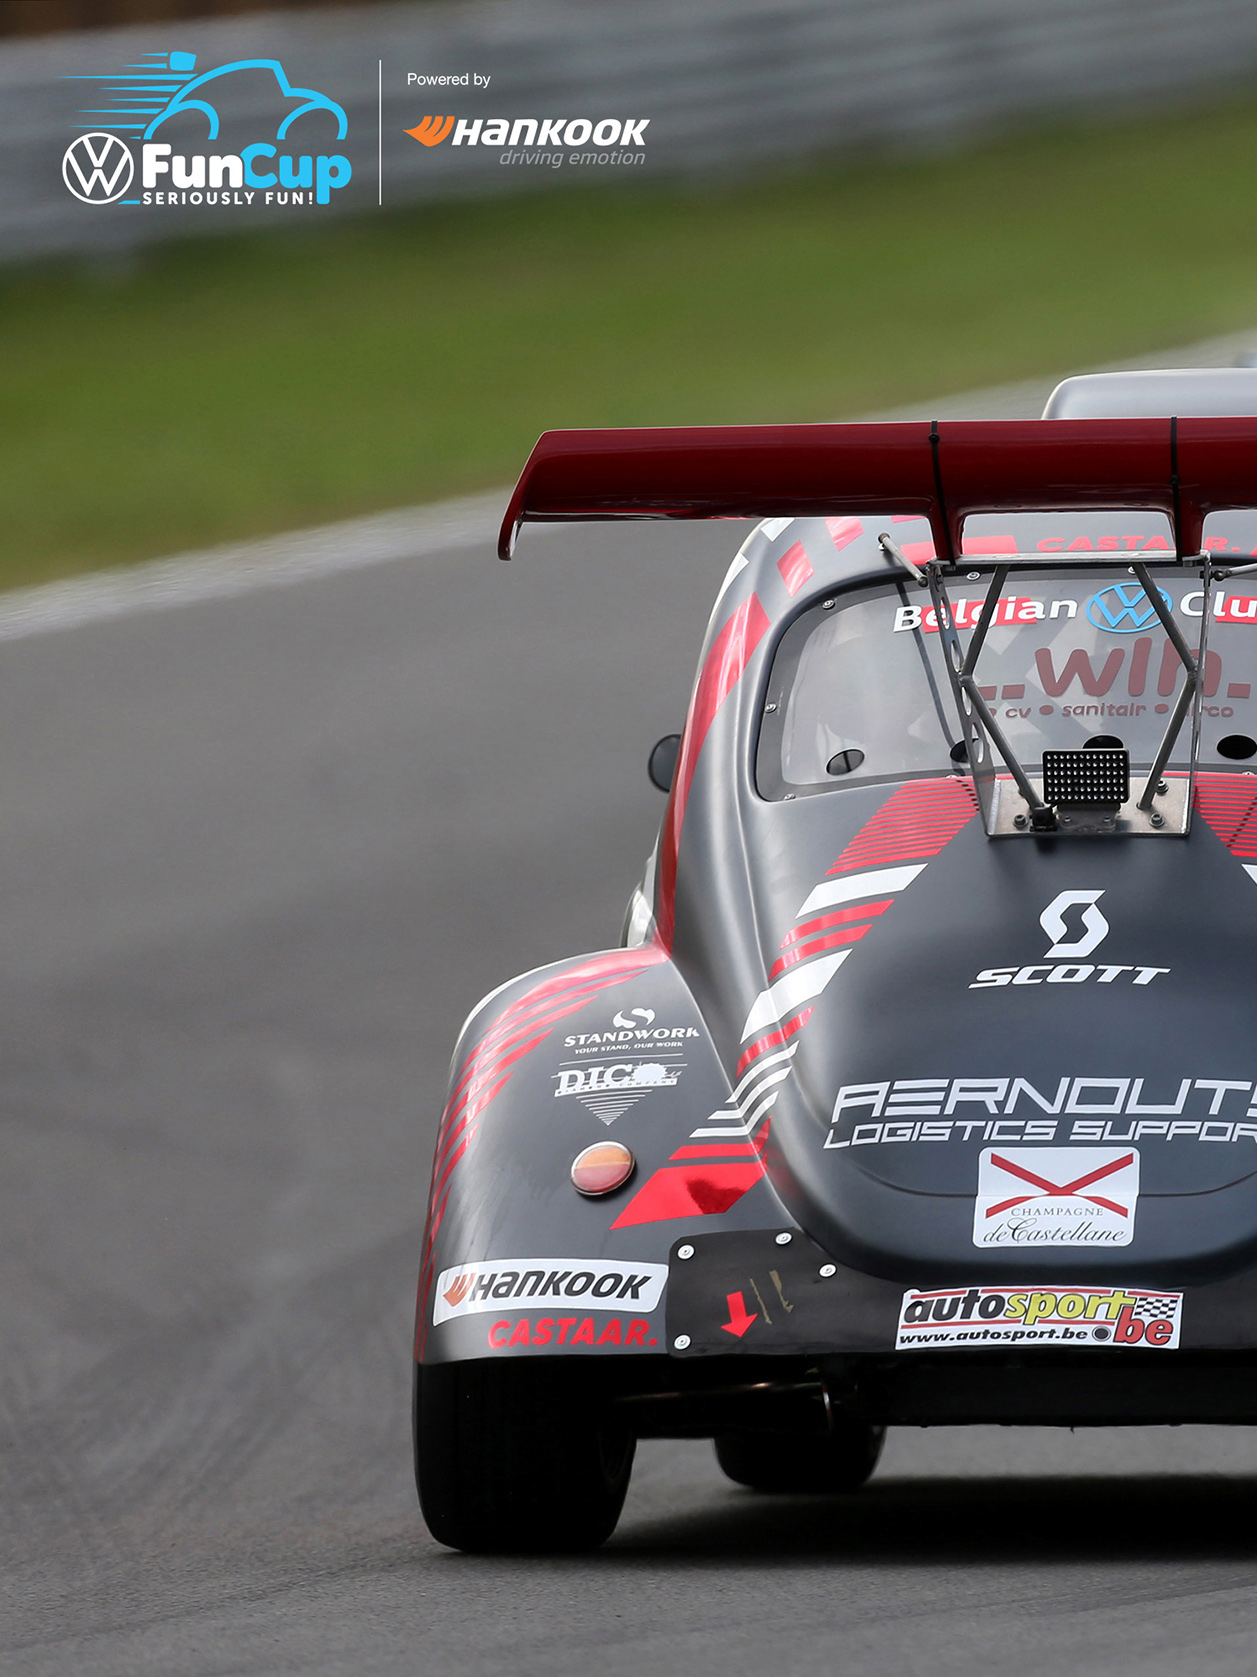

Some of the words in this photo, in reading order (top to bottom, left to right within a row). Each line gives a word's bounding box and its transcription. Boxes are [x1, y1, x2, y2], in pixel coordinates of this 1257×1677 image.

[1036, 535, 1241, 552] CASTAR.
[1005, 707, 1031, 718] cv
[1062, 703, 1146, 717] sanitair
[968, 964, 1171, 989] SCOTT
[564, 1027, 700, 1048] STANDWORK
[574, 1047, 598, 1055] YOUR
[600, 1042, 632, 1052] STAND,
[823, 1120, 1058, 1150] LOGISTICS
[1010, 1207, 1104, 1217] CHAMPAGNE
[904, 1289, 1136, 1325] autosport
[487, 1317, 658, 1349] CASTAAR.
[900, 1325, 1088, 1345] www.autosport.be
